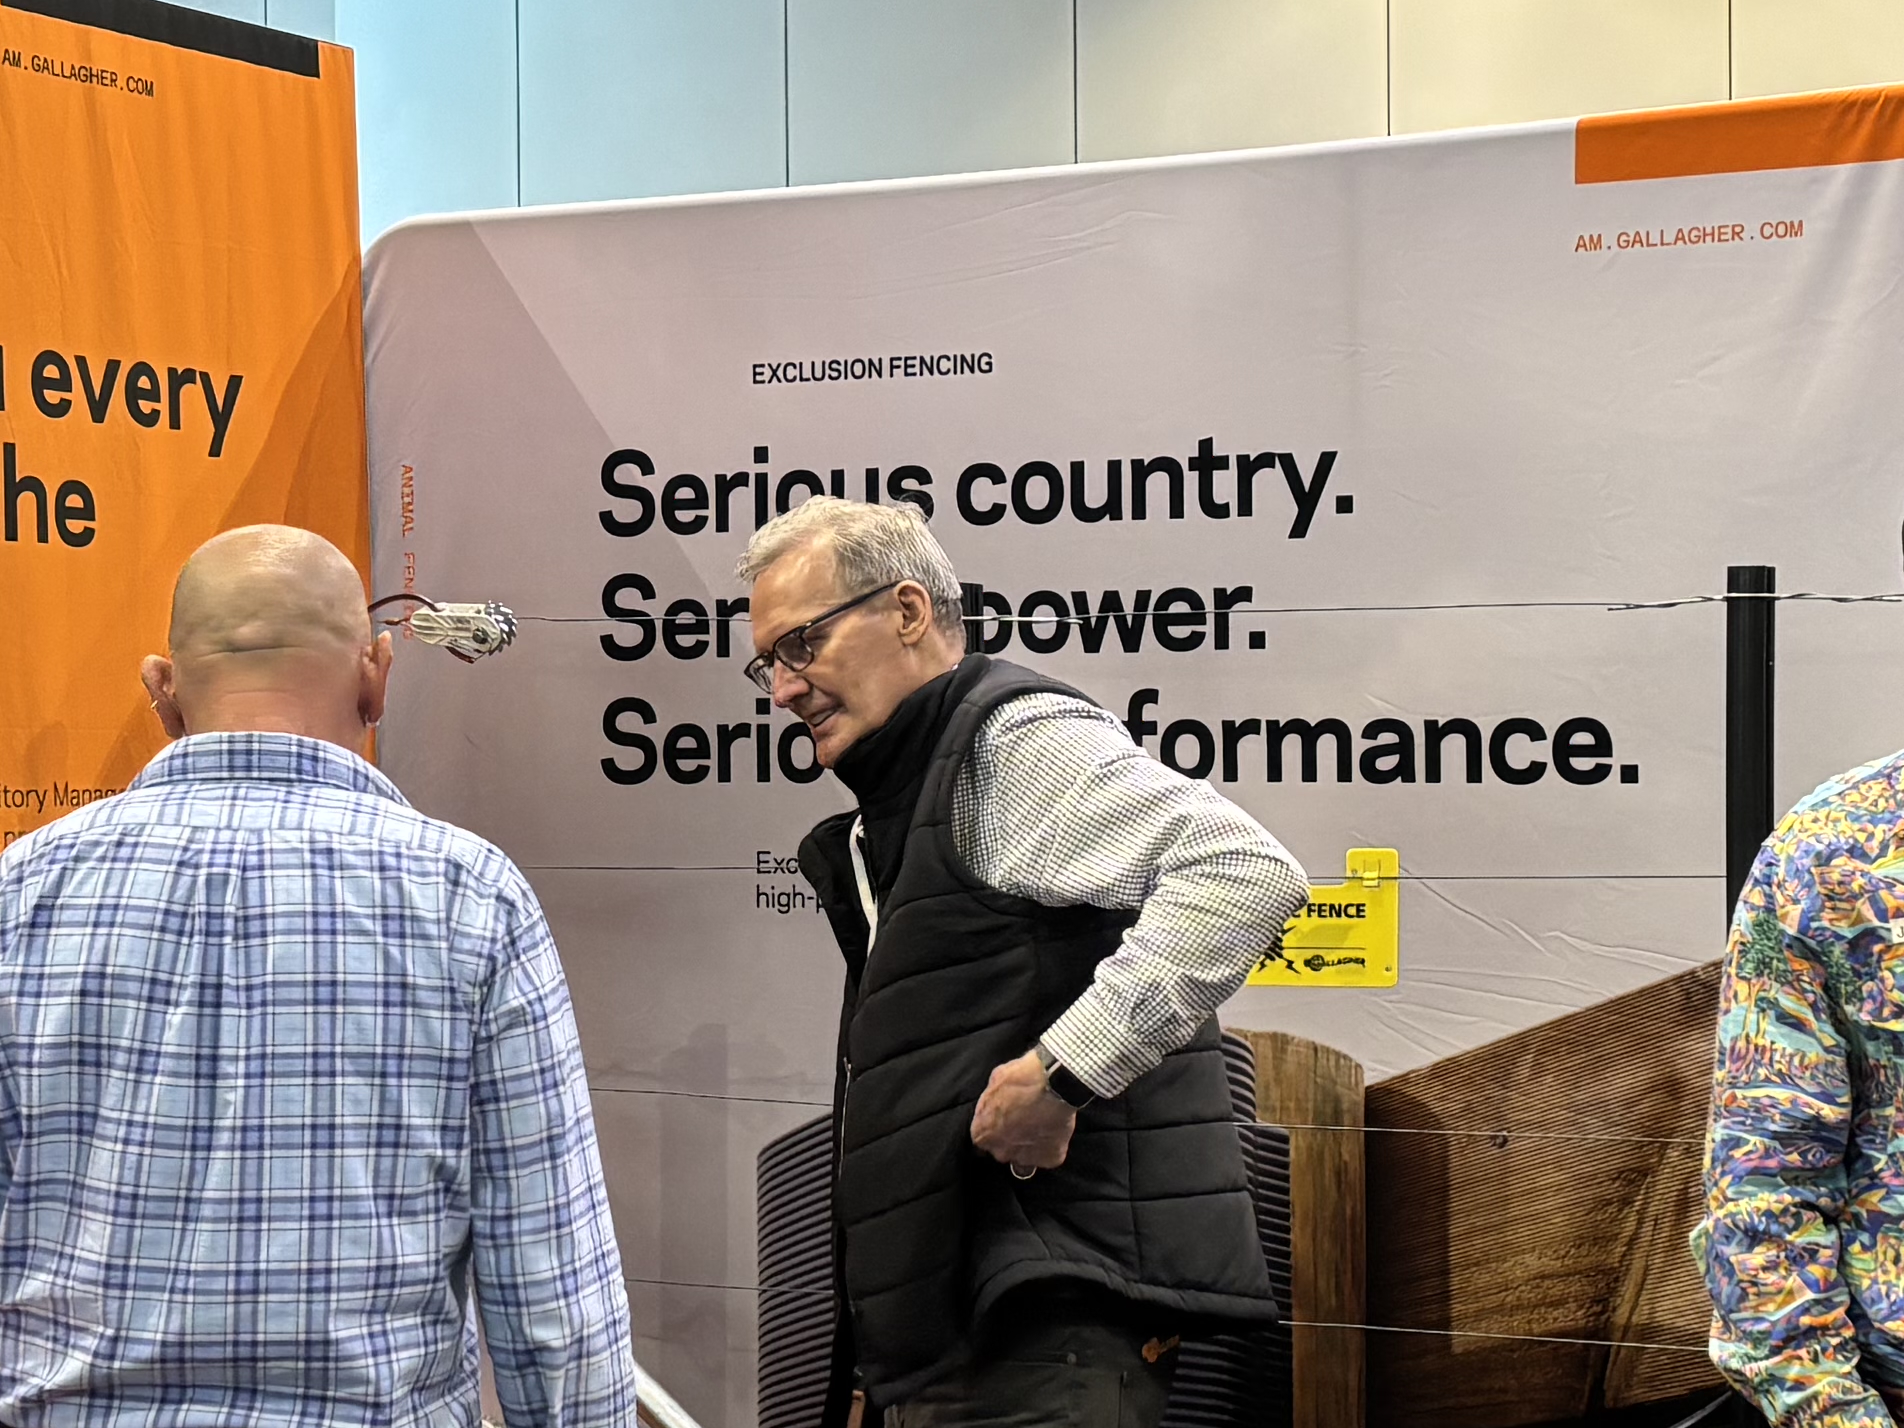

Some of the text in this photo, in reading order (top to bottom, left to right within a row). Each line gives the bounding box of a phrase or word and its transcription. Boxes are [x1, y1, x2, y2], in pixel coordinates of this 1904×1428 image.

[1, 48, 155, 97] AM.GALLAGHER.COM
[1574, 220, 1804, 253] AM.GALLAGHER.COM
[752, 352, 993, 385] EXCLUSION FENCING
[30, 349, 244, 458] every
[956, 436, 1355, 539] country.
[600, 688, 1639, 786] Serio formance.
[756, 850, 799, 875] Exc
[1306, 902, 1366, 919] FENCE
